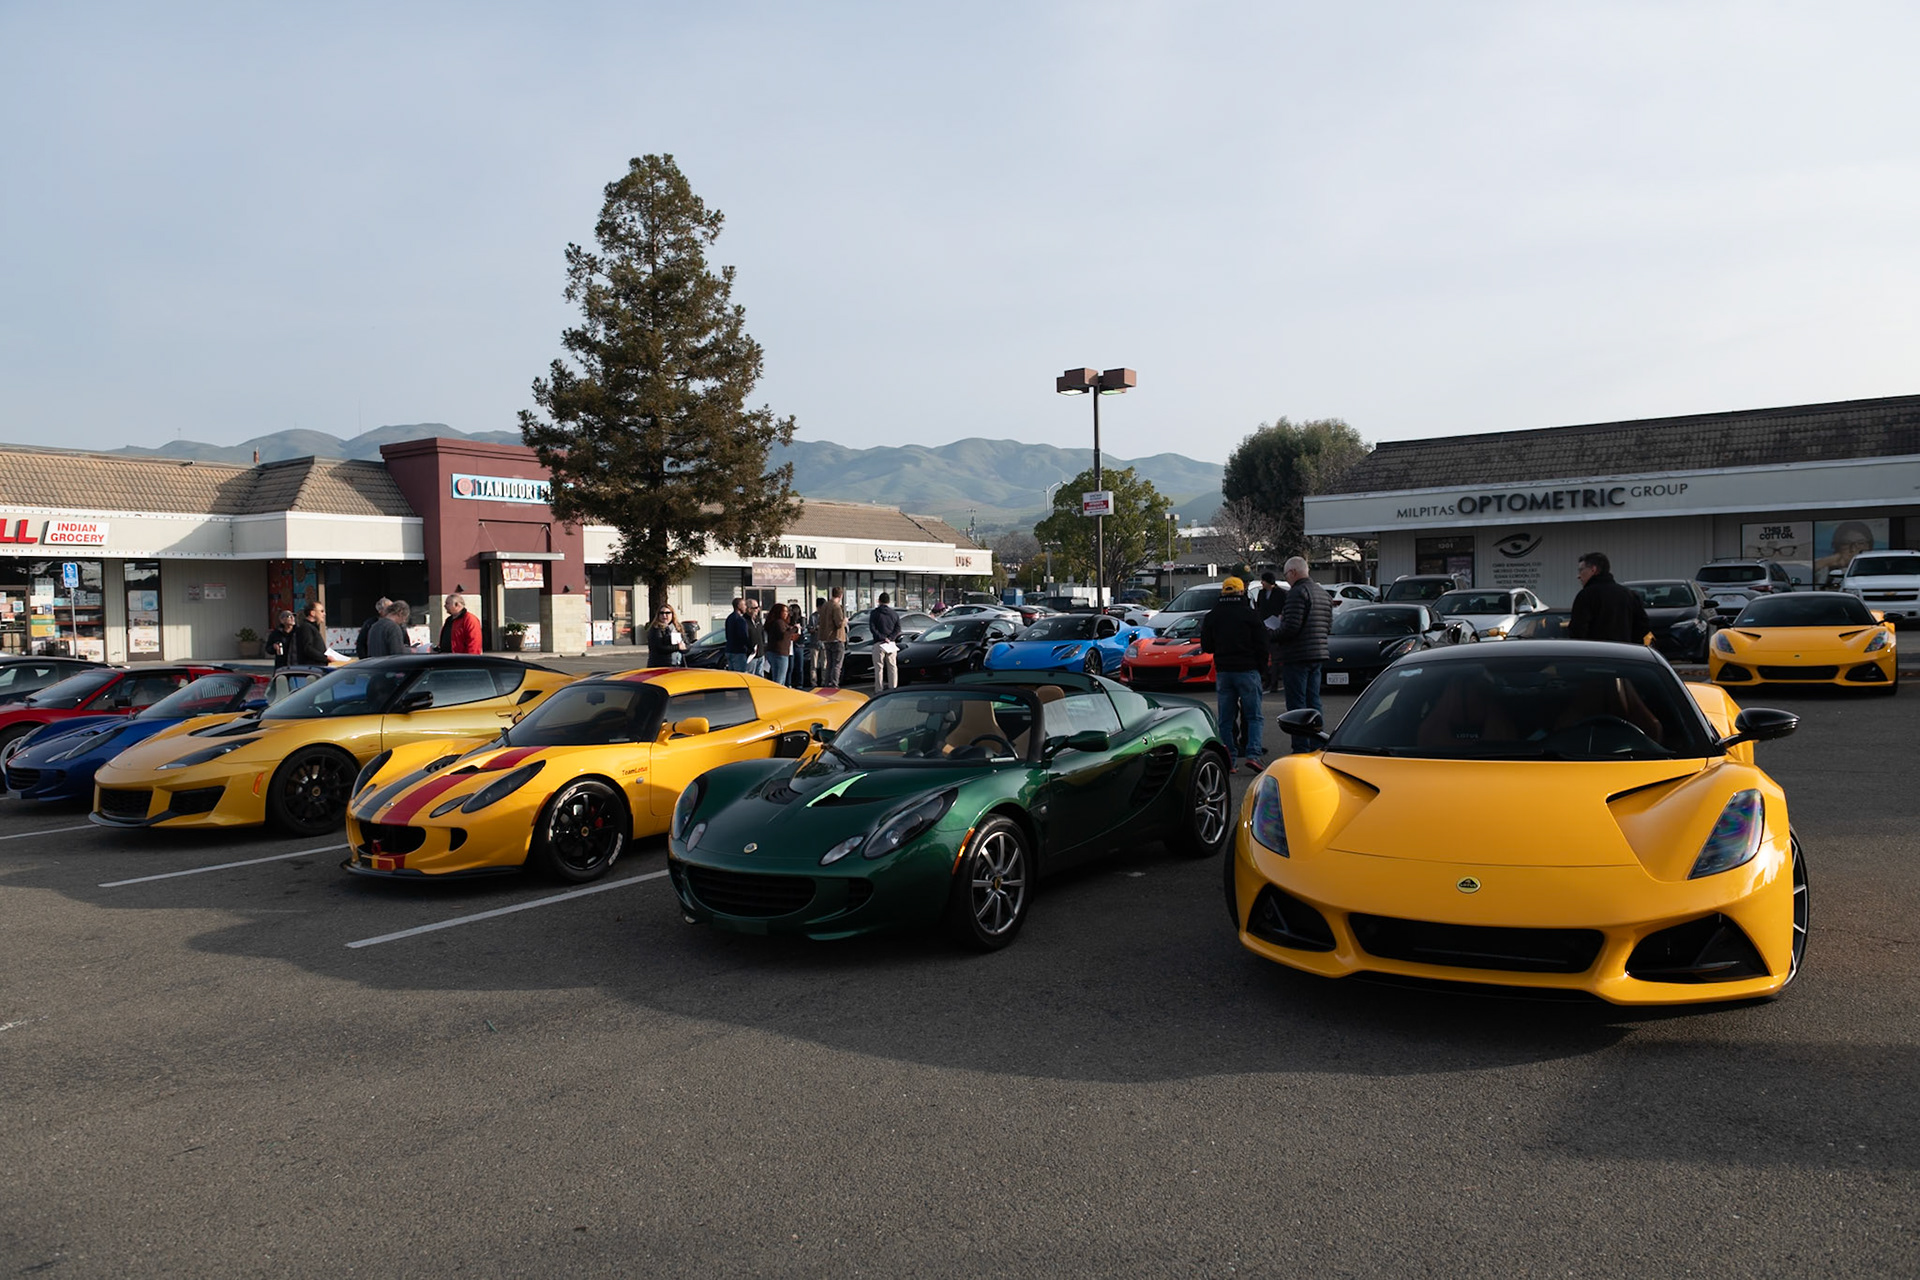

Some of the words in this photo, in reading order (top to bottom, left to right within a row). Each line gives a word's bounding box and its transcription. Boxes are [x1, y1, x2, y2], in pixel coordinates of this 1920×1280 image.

[479, 480, 538, 500] TANDOORI
[1396, 505, 1455, 519] MILPITAS
[1457, 487, 1626, 515] OPTOMETRIC
[1630, 483, 1688, 498] GROUP
[57, 522, 97, 533] INDIAN
[1763, 526, 1781, 534] THIS
[50, 532, 105, 543] GROCERY
[796, 544, 817, 559] BAR
